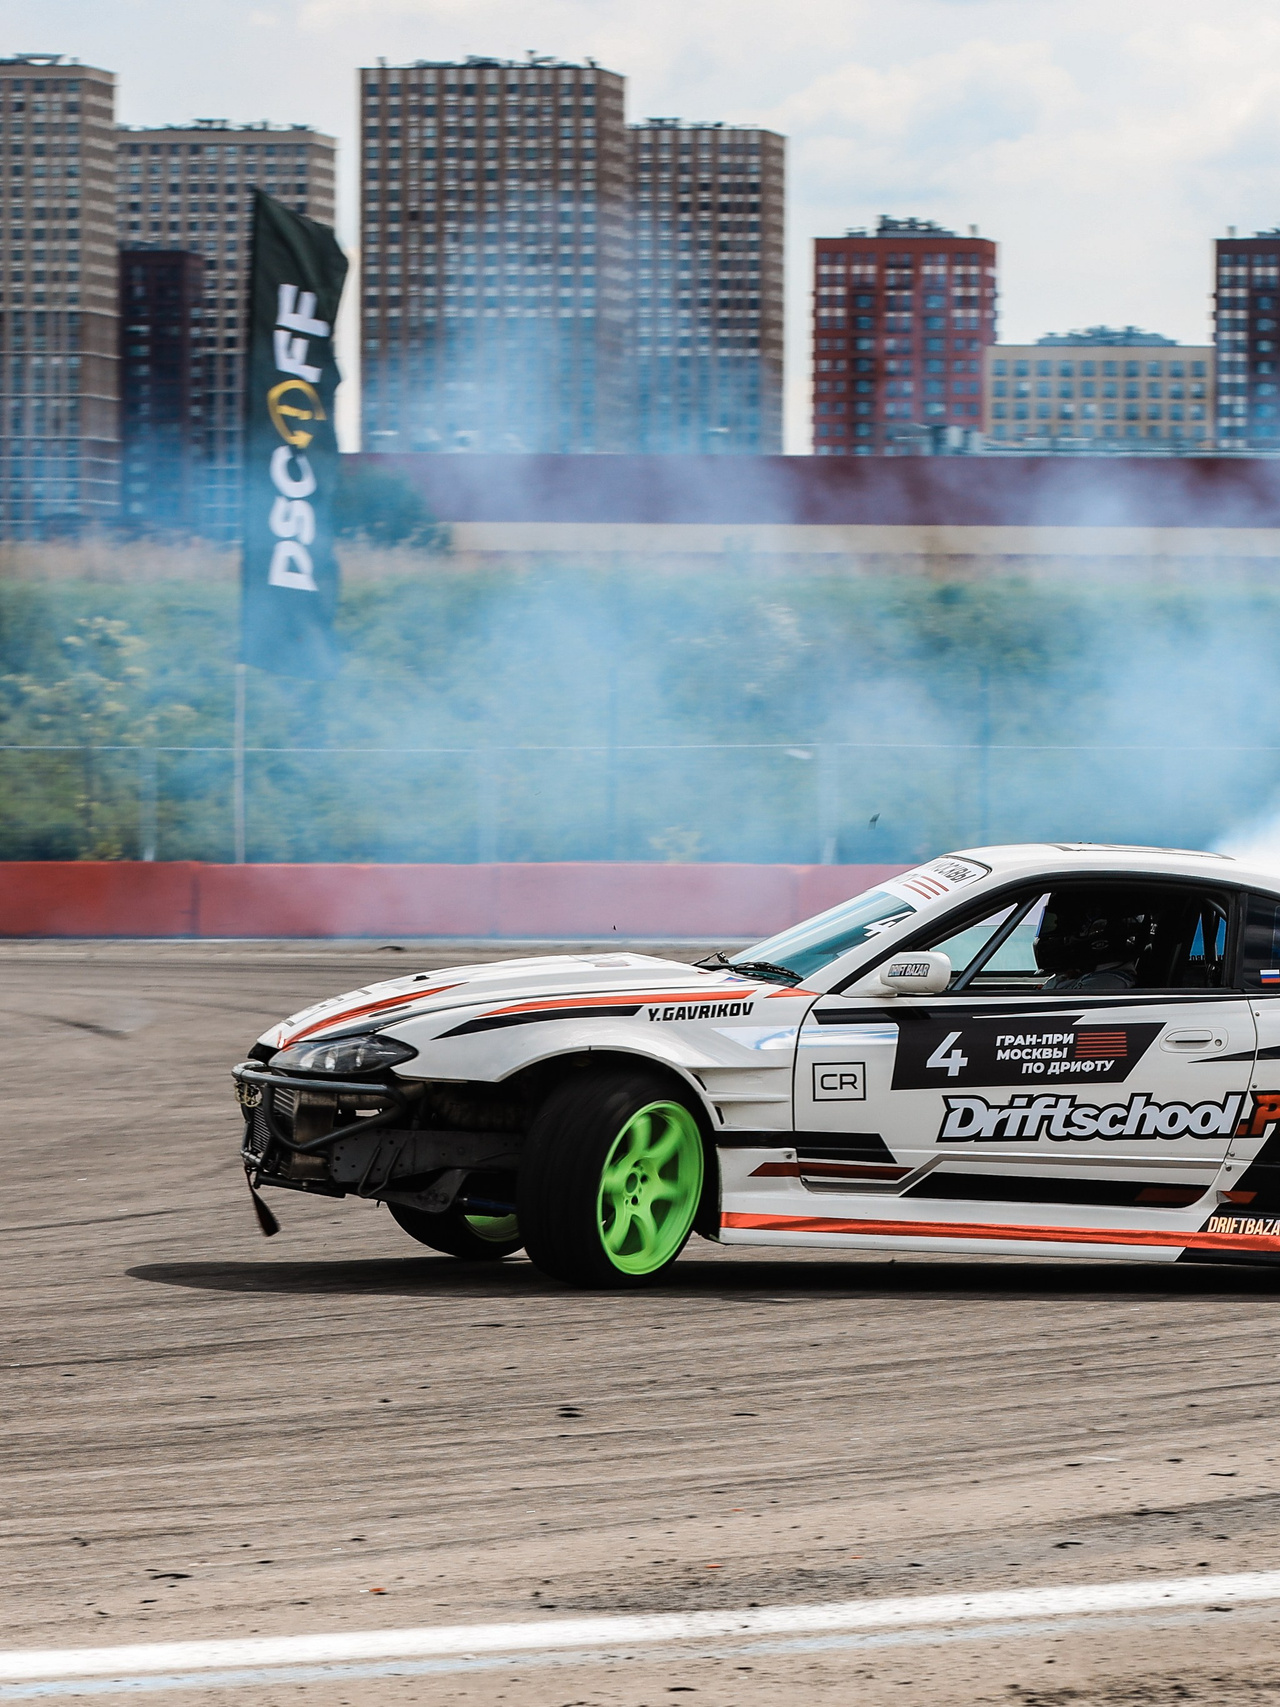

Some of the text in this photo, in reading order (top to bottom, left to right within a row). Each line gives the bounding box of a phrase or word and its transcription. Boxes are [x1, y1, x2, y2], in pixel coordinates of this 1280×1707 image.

[996, 1033, 1075, 1047] ГРАН-ПРИ
[926, 1031, 969, 1077] 4
[996, 1048, 1068, 1061] МОСКВЫ
[1021, 1060, 1115, 1075] ПО ДРИФТУ
[820, 1073, 858, 1090] CR
